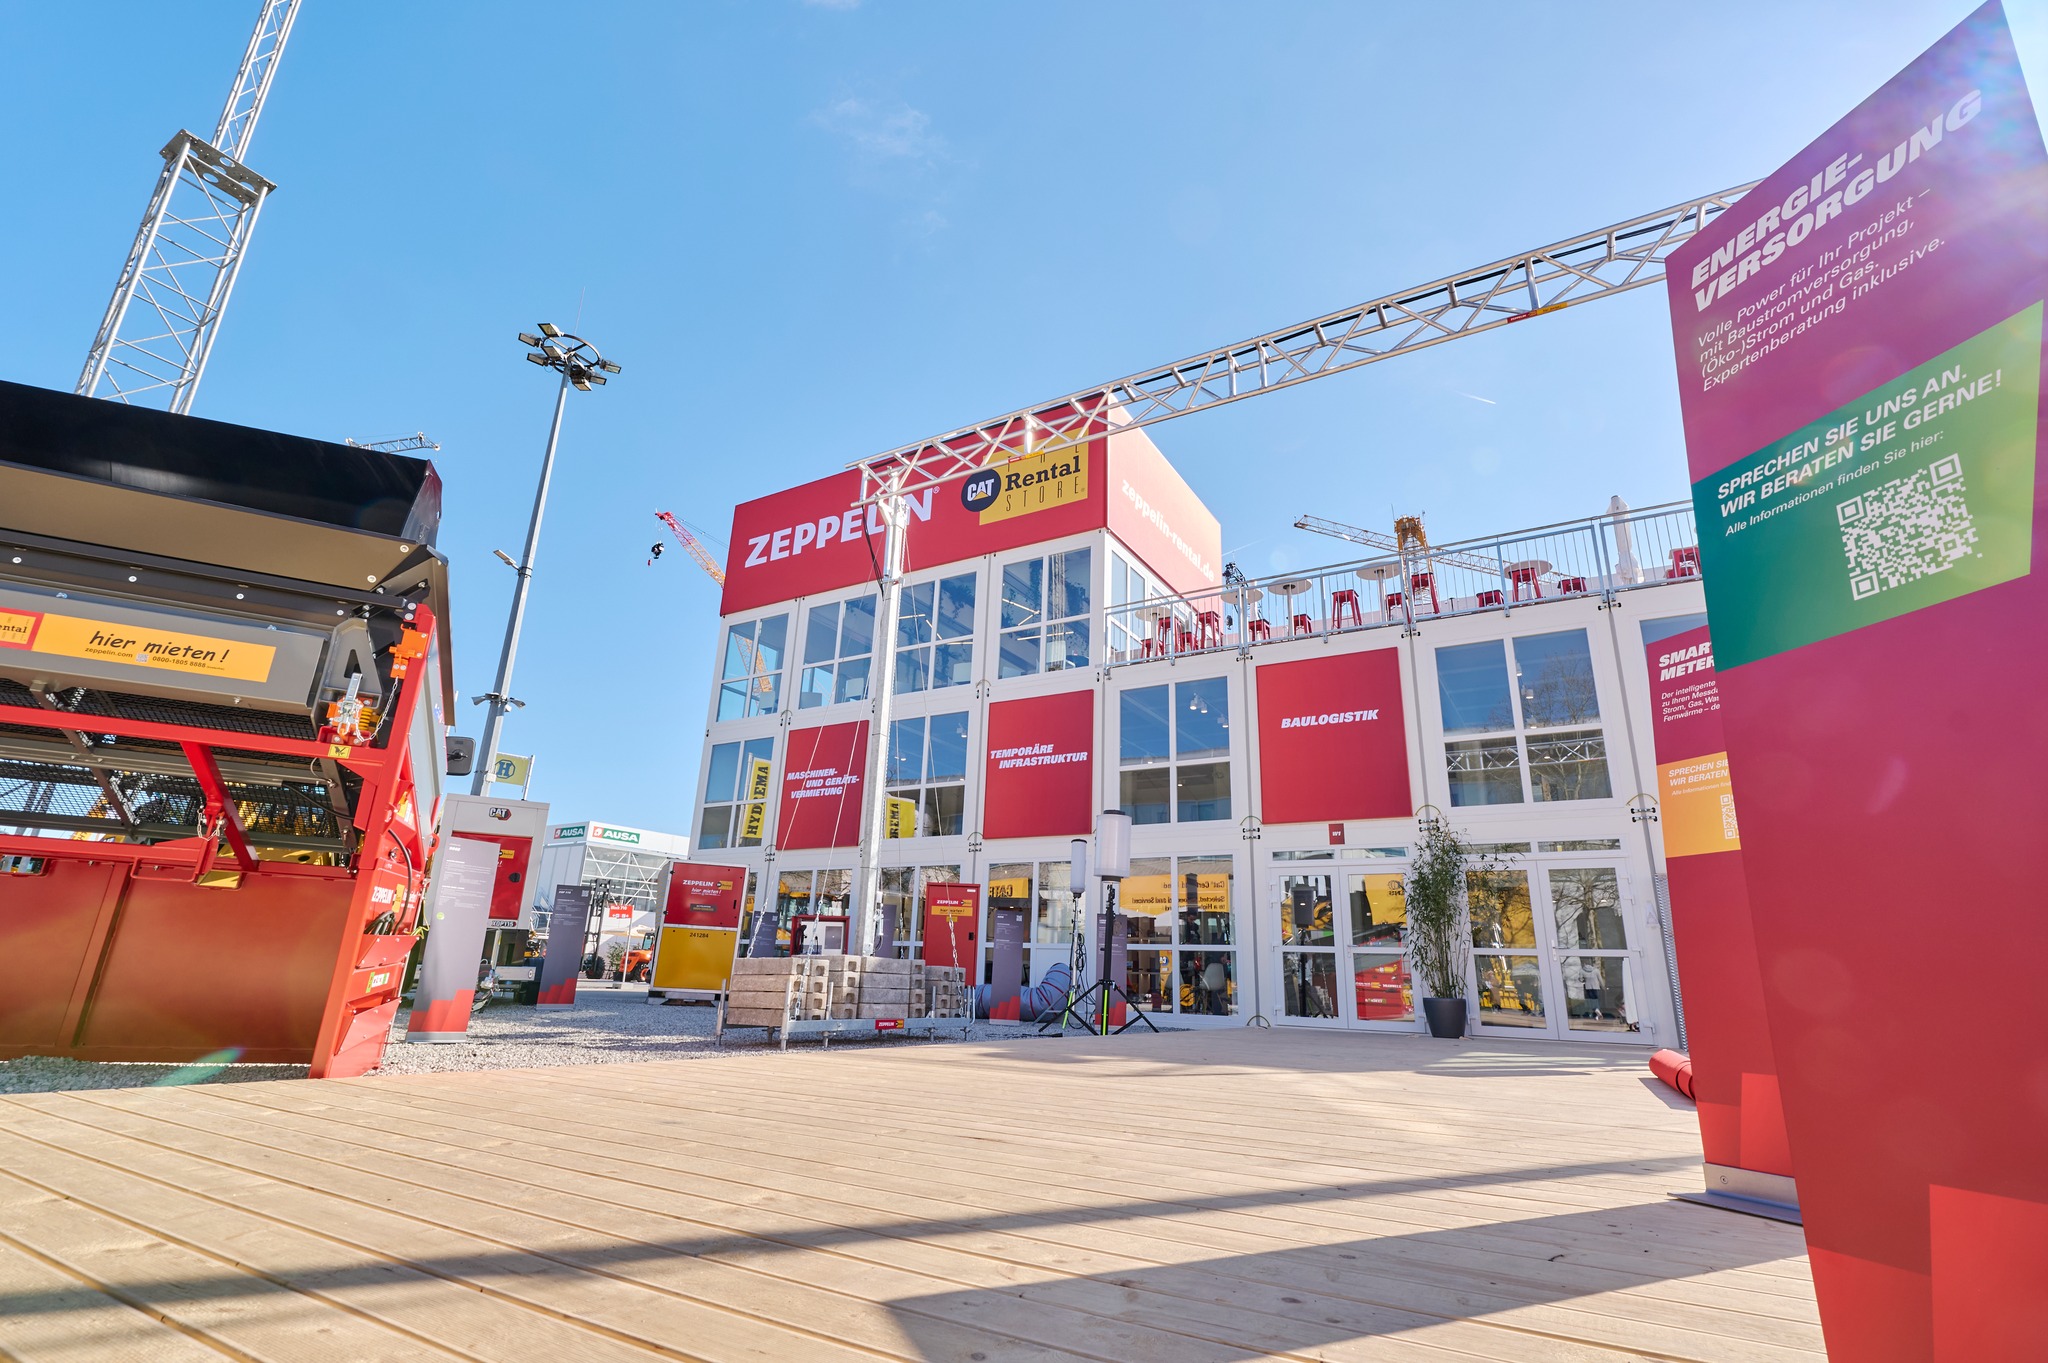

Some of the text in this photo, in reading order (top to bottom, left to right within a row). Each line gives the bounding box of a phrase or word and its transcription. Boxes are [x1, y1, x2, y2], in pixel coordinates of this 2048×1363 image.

[1695, 89, 1982, 312] VERSORGUNG
[1691, 152, 1863, 290] ENERGIE-
[1698, 319, 1733, 348] Volle
[1737, 283, 1785, 323] Power
[1790, 267, 1812, 293] für
[1818, 247, 1843, 277] Ihr
[1848, 196, 1915, 249] Projekt
[1699, 220, 1915, 364] mit Baustromversorgung,
[1701, 260, 1879, 378] (Öko-)Strom und Gas.
[1703, 239, 1946, 392] Expertenberatung inklusive.
[1717, 364, 1967, 500] SPRECHEN SIE UNS AN.
[1720, 368, 2002, 518] WIR BERATEN SIE GERNE!
[1005, 455, 1081, 492] Rental
[1725, 430, 1944, 537] Alle Informationen finden Sie hier:
[967, 478, 995, 502] CAT
[1006, 476, 1079, 512] STORE
[744, 486, 940, 568] ZEPPELN®
[1122, 479, 1214, 583] zeppelin-rental.de
[84, 647, 133, 658] zeppelin.com
[89, 630, 136, 650] hier
[143, 641, 216, 662] mieten
[1659, 641, 1711, 667] SMAR
[1661, 681, 1716, 700] Der intelligente
[1671, 695, 1690, 705] Ihren
[1662, 704, 1686, 715] Strom,
[1688, 700, 1704, 709] Gas,
[1663, 708, 1703, 722] Fernwärme
[1281, 709, 1379, 729] BAULOGISTIK
[990, 743, 1054, 759] TEMPORÄRE
[998, 752, 1088, 769] INFRASTRUKTUR
[786, 767, 838, 781] MASCHINEN-
[1668, 762, 1714, 777] SPRECHEN
[1670, 769, 1728, 786] WIR BERATEN
[806, 774, 860, 788] UND GERÄTE-
[790, 787, 843, 799] VERMIETUNG
[489, 807, 508, 819] CAT
[560, 828, 584, 837] AUSA
[603, 831, 639, 842] AUSA
